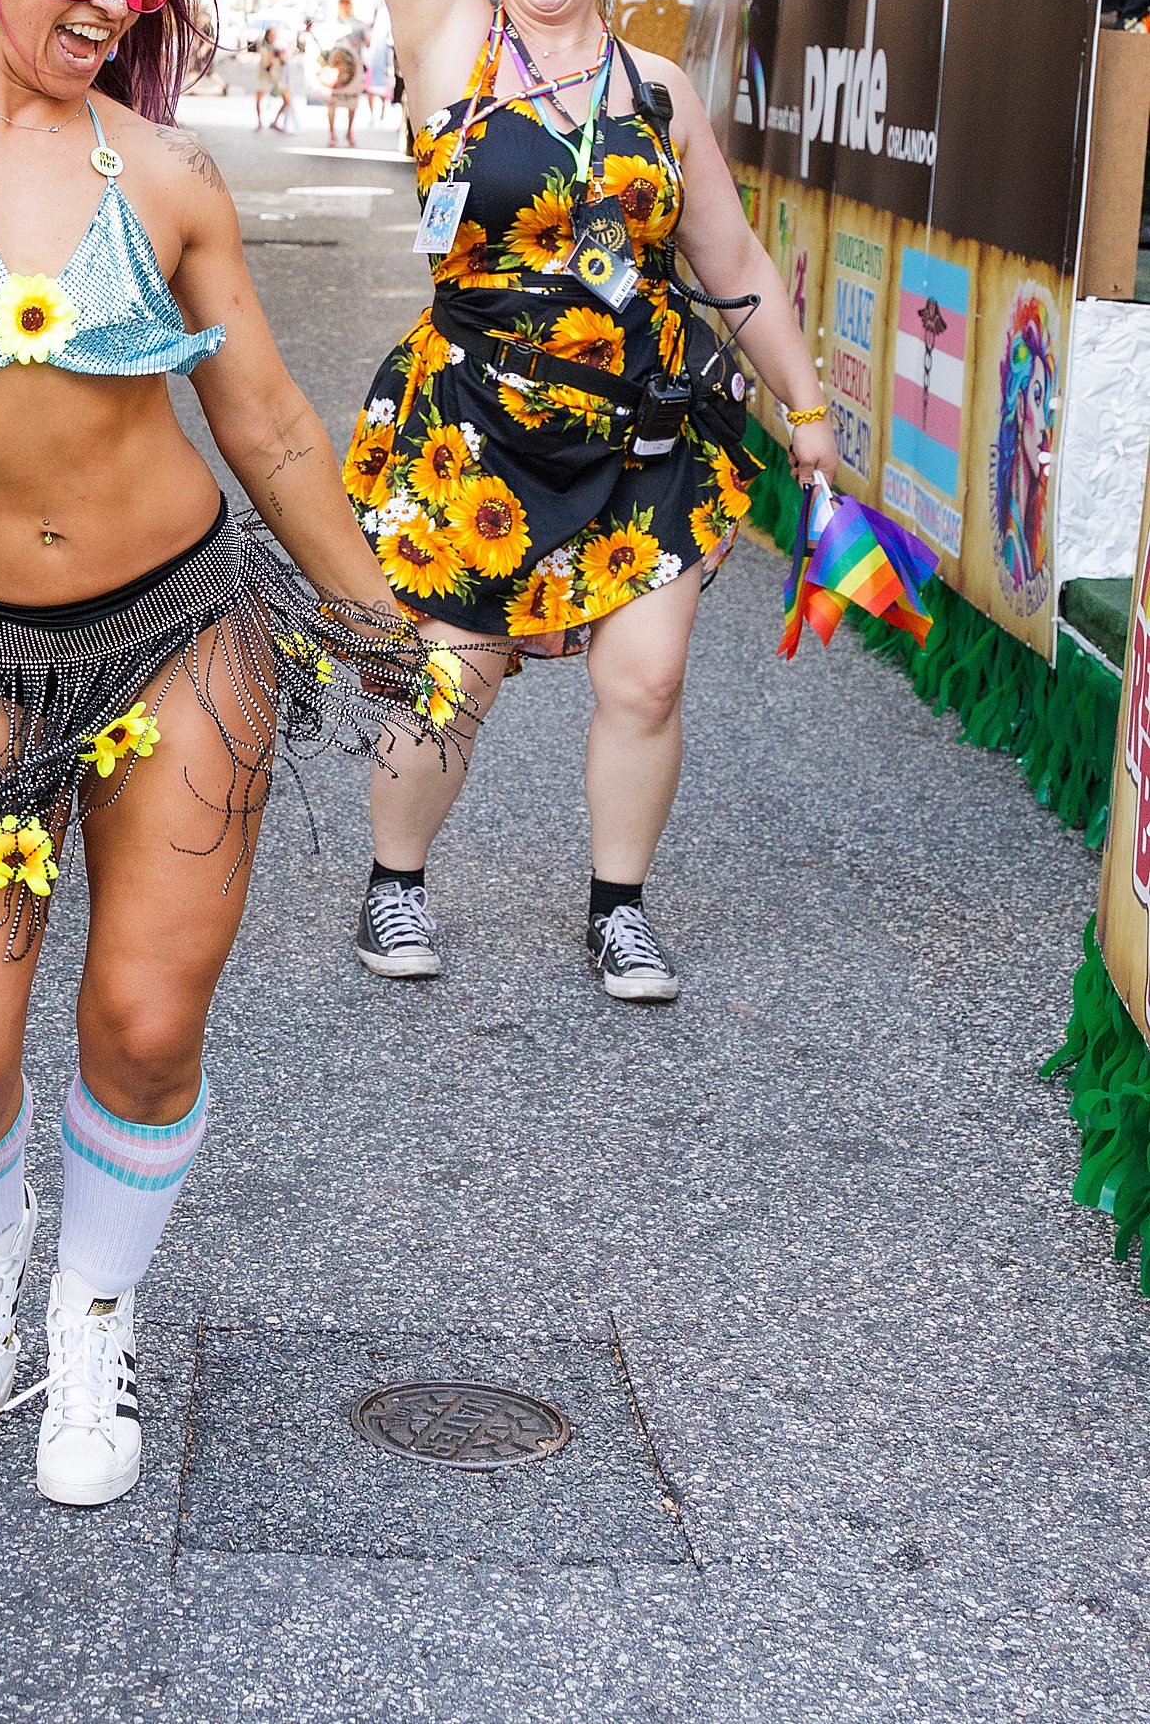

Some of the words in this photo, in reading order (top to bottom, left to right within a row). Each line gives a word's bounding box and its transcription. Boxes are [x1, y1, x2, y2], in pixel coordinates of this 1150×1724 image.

[505, 22, 519, 40] VIP
[527, 61, 541, 79] VIP
[595, 129, 605, 144] VIP
[887, 125, 937, 166] ORLANDO
[99, 151, 117, 162] She
[833, 277, 875, 352] MAKE
[830, 347, 872, 412] AMERICA
